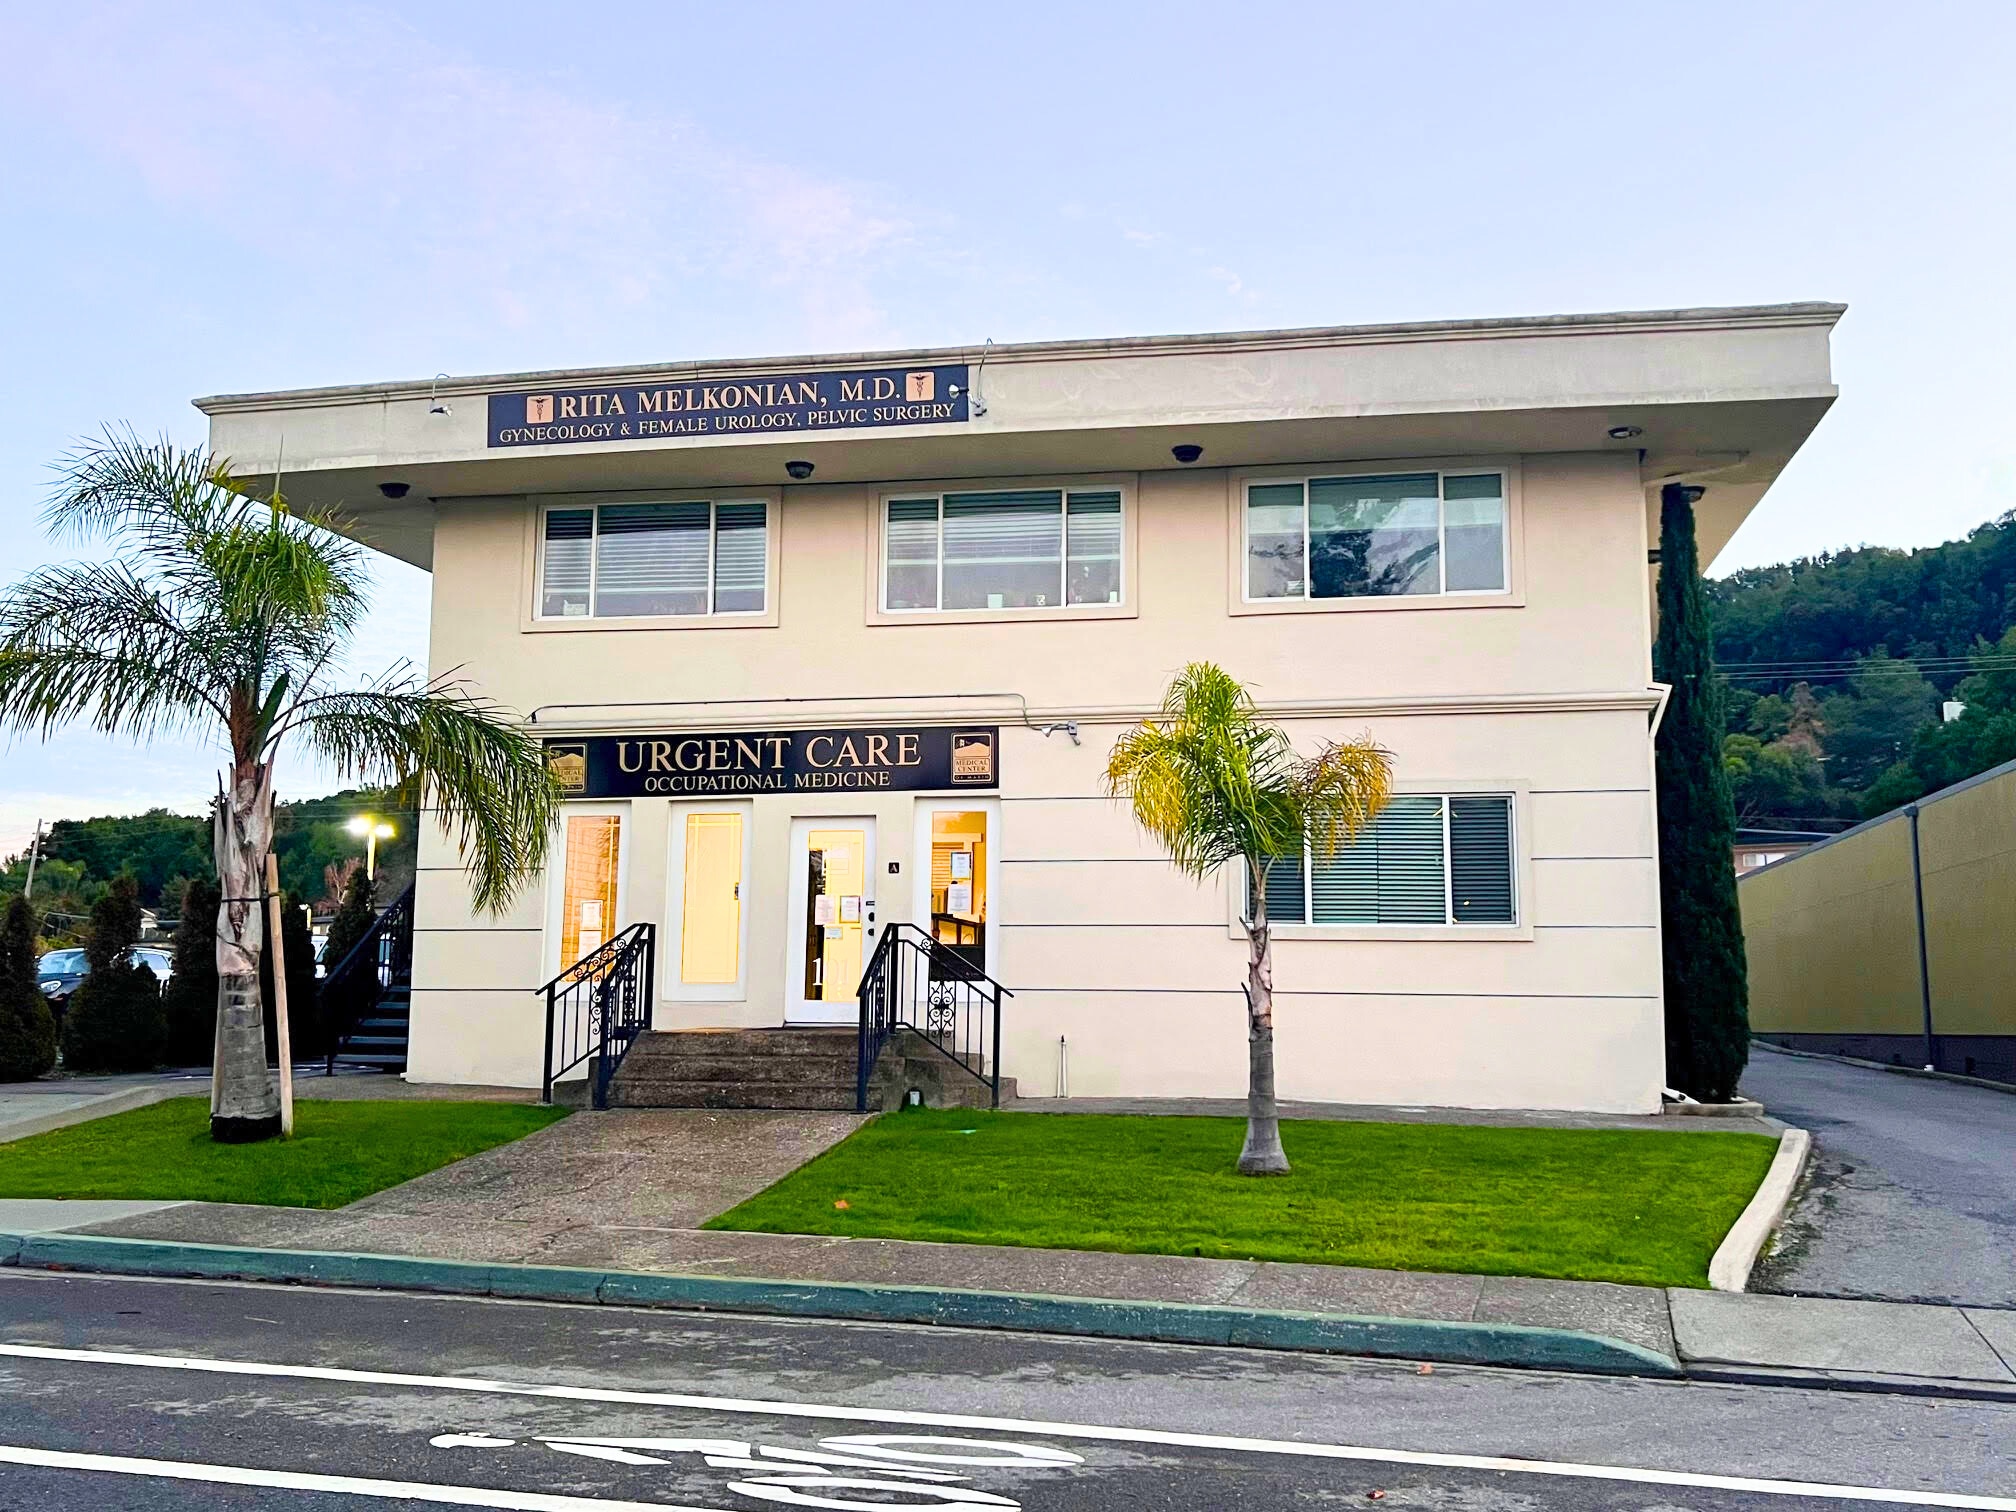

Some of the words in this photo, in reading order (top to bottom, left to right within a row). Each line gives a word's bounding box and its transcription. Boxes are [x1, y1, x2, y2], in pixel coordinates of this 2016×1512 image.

[559, 394, 626, 419] RITA
[638, 381, 828, 414] MELKONIAN,
[839, 377, 901, 403] M.D.
[500, 423, 615, 443] GYNECOLOGY
[620, 423, 631, 436] &
[638, 418, 708, 435] FEMALE
[808, 408, 868, 425] PELVIC
[873, 403, 955, 421] SURGERY
[616, 737, 792, 773] URGENT
[805, 734, 922, 768] CARE
[645, 773, 788, 791] OCCUPATIONAL
[794, 771, 891, 788] MEDICINE
[890, 864, 898, 873] A
